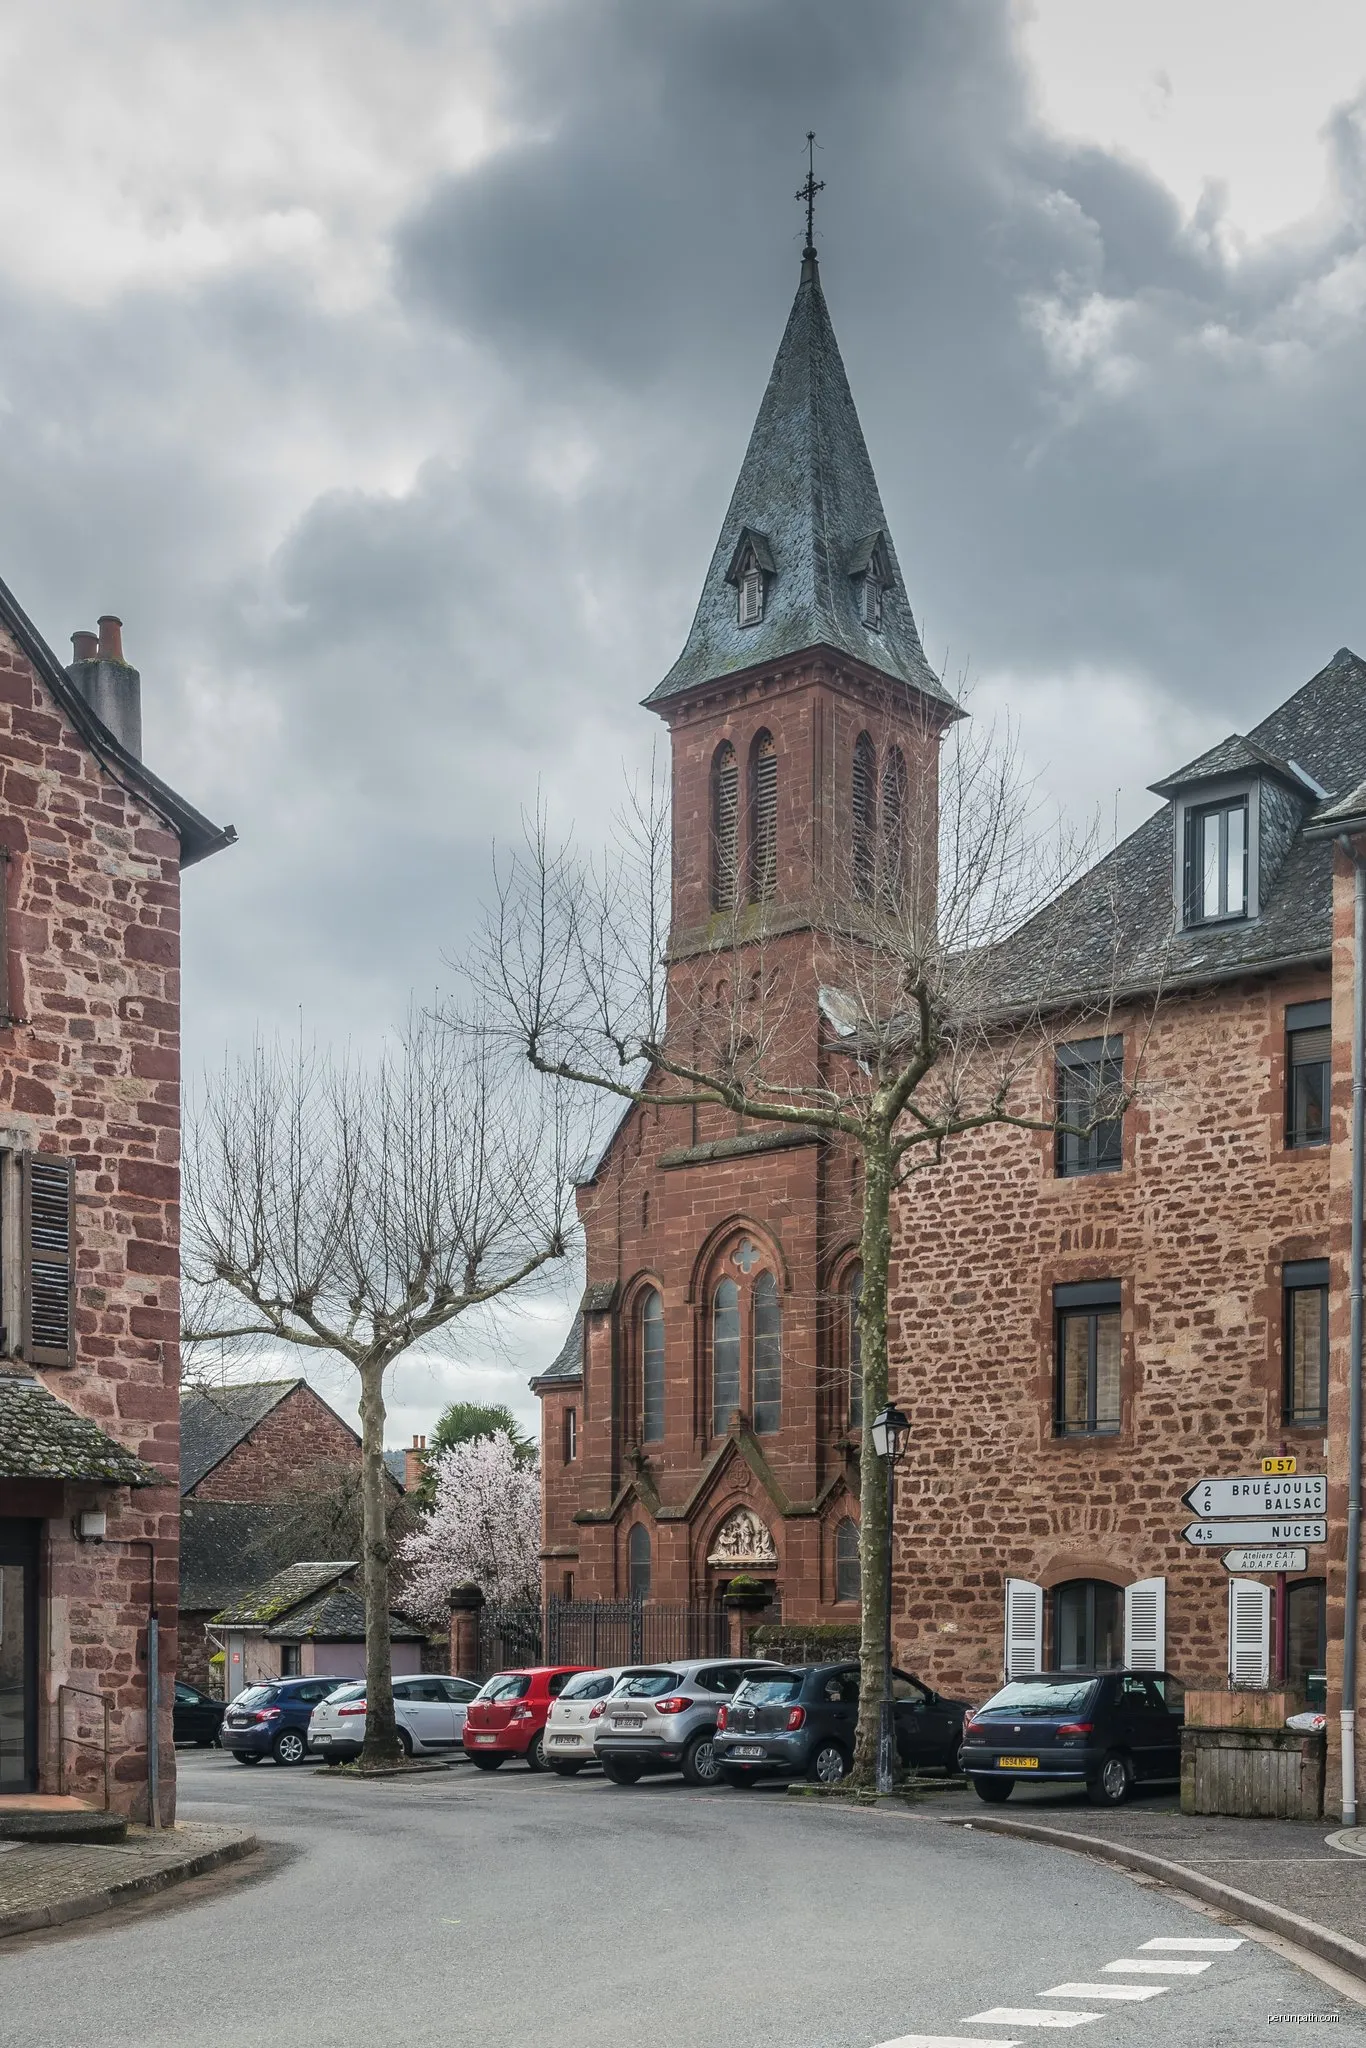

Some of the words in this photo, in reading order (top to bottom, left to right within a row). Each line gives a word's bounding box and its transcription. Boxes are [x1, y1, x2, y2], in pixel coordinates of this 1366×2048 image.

[1264, 1460, 1272, 1471] D
[1277, 1460, 1293, 1471] 57
[1204, 1486, 1212, 1497] 2
[1232, 1481, 1322, 1496] BRUÉJOULS
[1204, 1501, 1211, 1511] 6
[1265, 1497, 1321, 1510] BALSAC
[1195, 1528, 1213, 1540] 4,5
[1272, 1525, 1321, 1537] NUCES
[1243, 1552, 1273, 1560] Ateliers
[1276, 1551, 1296, 1559] C.A.T.
[1001, 1758, 1018, 1766] 1694
[1019, 1758, 1027, 1766] NS
[1029, 1758, 1037, 1766] 12
